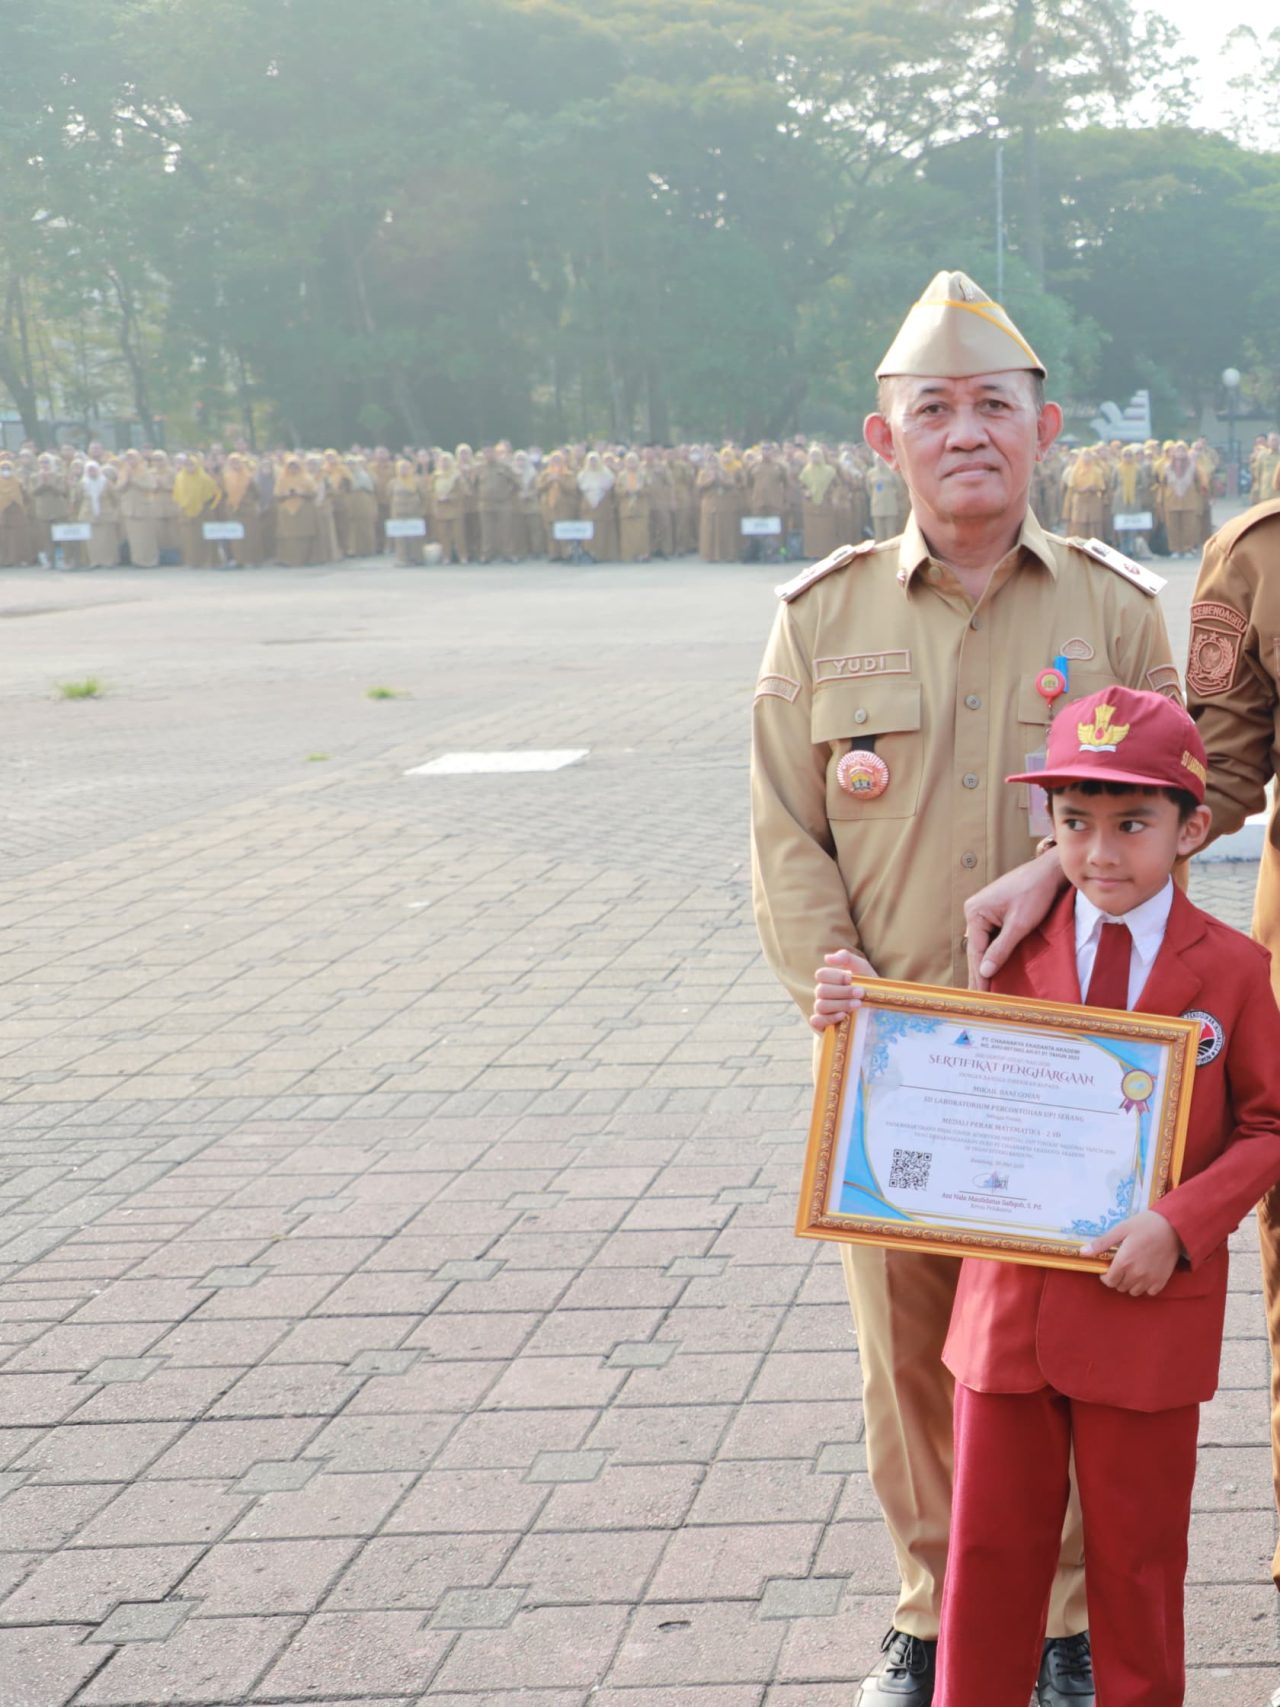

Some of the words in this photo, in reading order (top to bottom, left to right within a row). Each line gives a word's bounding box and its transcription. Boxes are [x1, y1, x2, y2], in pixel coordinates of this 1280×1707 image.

[832, 656, 886, 675] YUDI
[928, 1053, 998, 1073] SERTIFIKAT
[1002, 1063, 1094, 1085] PENGHARGAAN
